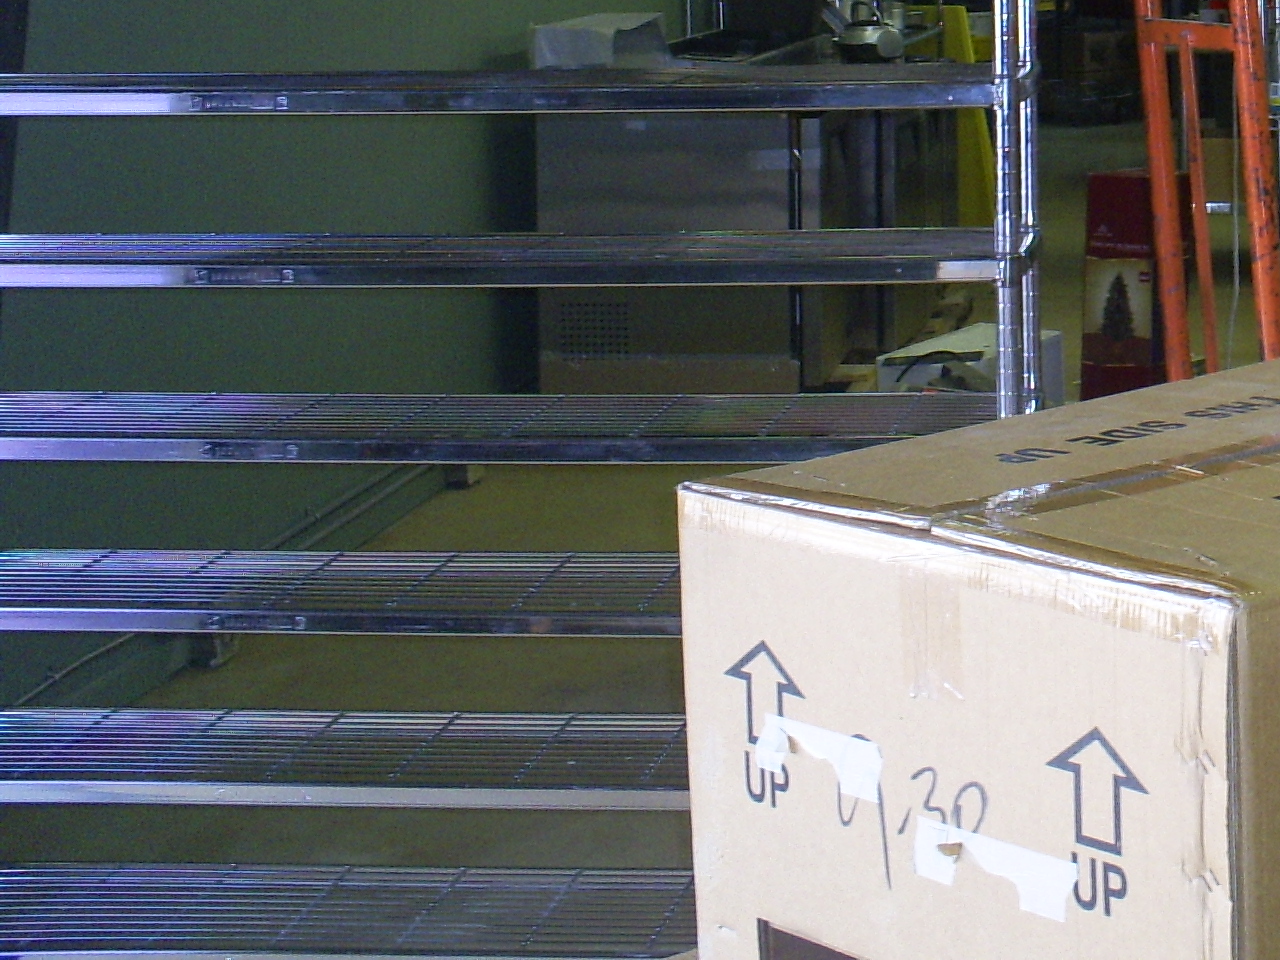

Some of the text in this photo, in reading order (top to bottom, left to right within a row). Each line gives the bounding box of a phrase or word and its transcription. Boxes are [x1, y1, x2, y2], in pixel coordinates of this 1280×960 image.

[1065, 420, 1187, 446] SIDE
[995, 447, 1072, 464] UP
[744, 750, 789, 808] UP
[1071, 852, 1129, 917] UP
